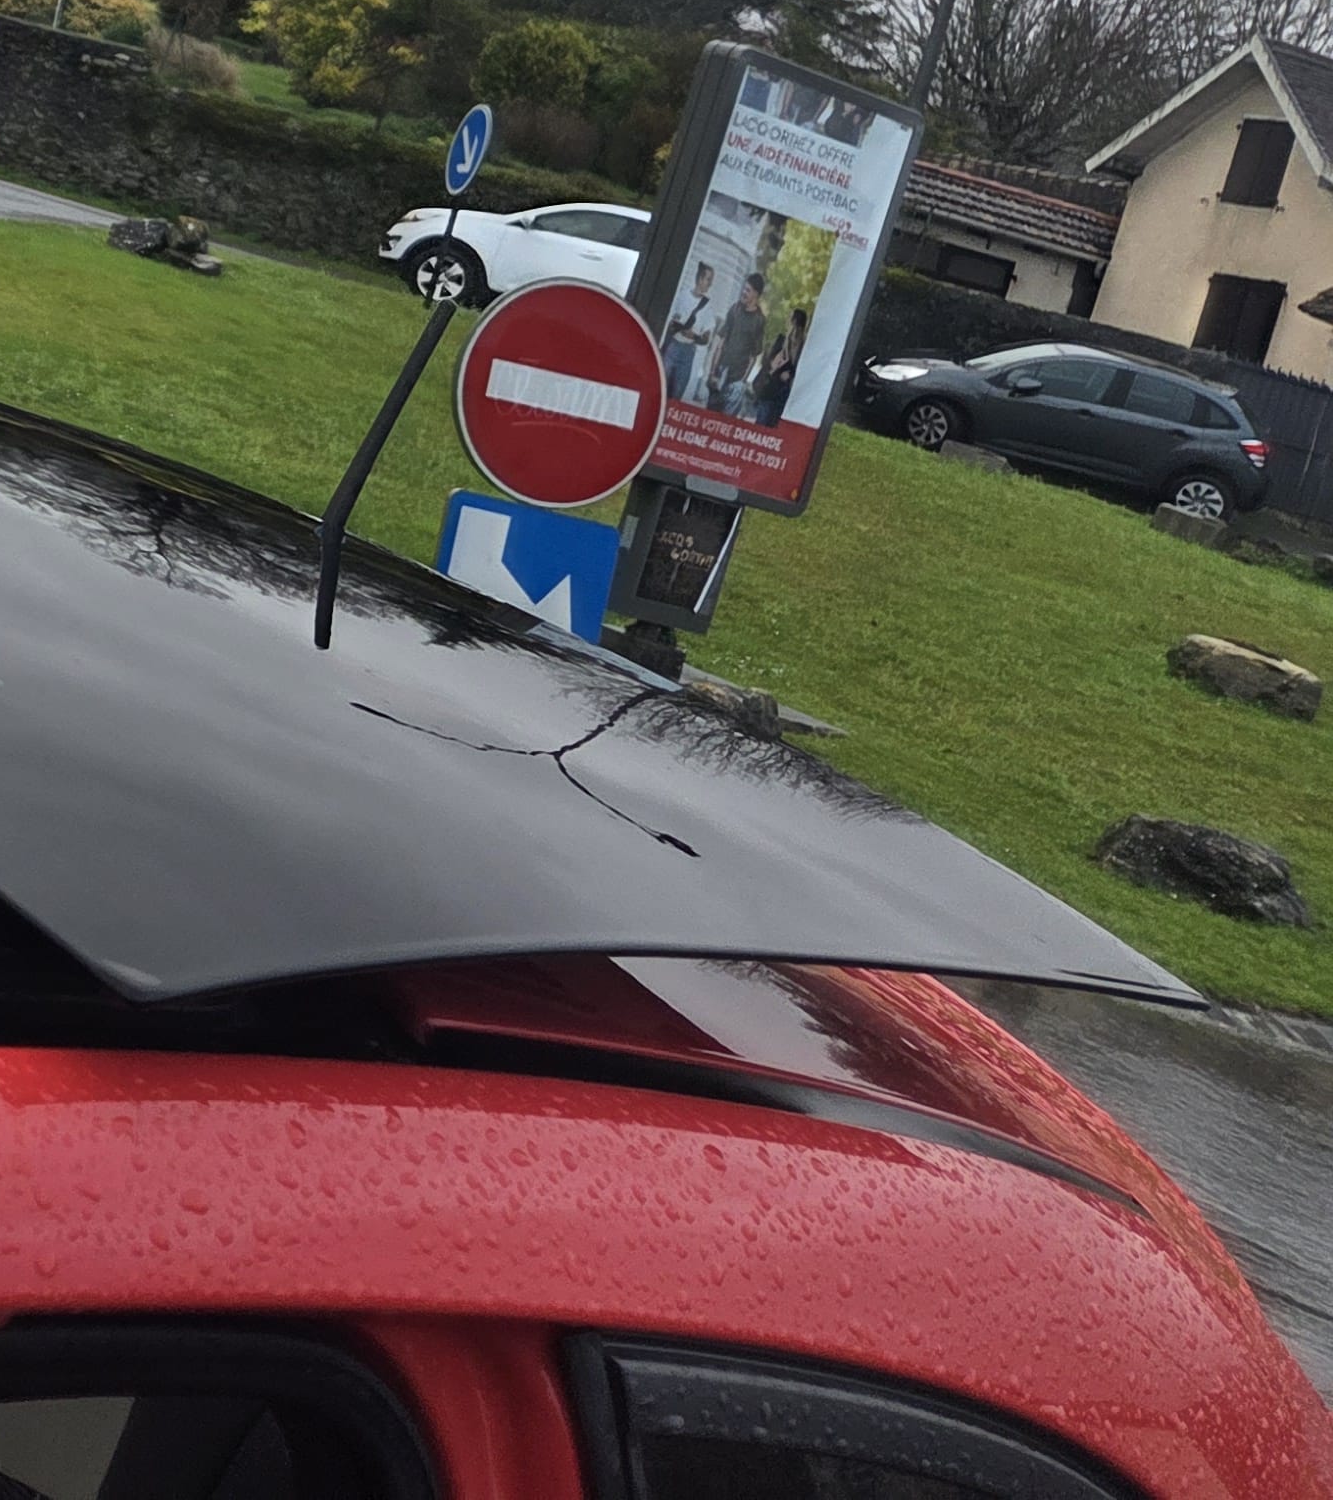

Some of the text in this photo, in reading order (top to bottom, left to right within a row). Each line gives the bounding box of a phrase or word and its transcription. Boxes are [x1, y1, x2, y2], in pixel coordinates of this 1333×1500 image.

[720, 153, 742, 173] AUX
[743, 160, 803, 194] ÉTUDIANTS
[728, 131, 852, 190] UNE AIDE FINANCIÈRE
[818, 143, 856, 168] OFFRE
[661, 424, 677, 439] EN
[676, 427, 710, 449] LIGNE
[709, 439, 742, 457] AVANT
[741, 448, 754, 463] LE
[667, 407, 784, 452] FAITES VOTRE DEMANDE
